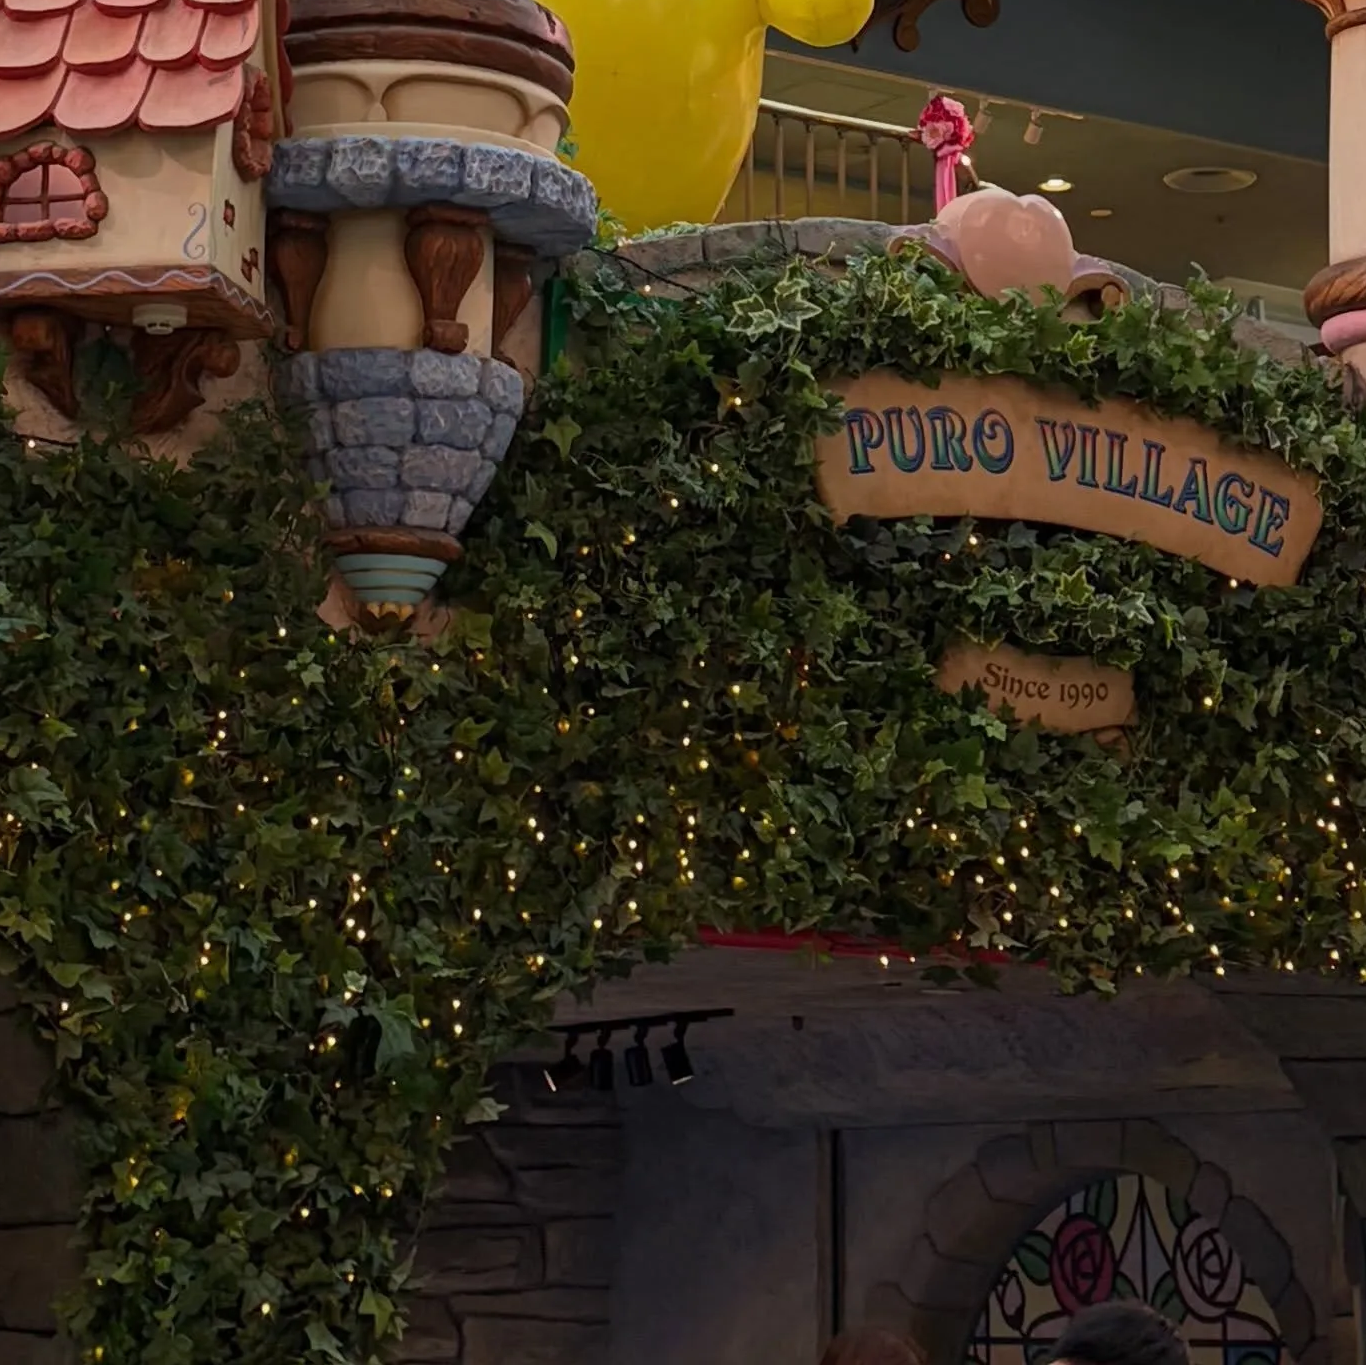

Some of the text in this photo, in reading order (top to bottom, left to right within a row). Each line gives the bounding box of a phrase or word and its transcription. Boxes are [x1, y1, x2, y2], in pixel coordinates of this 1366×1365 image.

[844, 405, 1291, 558] PURO VILLAGE
[983, 662, 1109, 709] Since 1990
